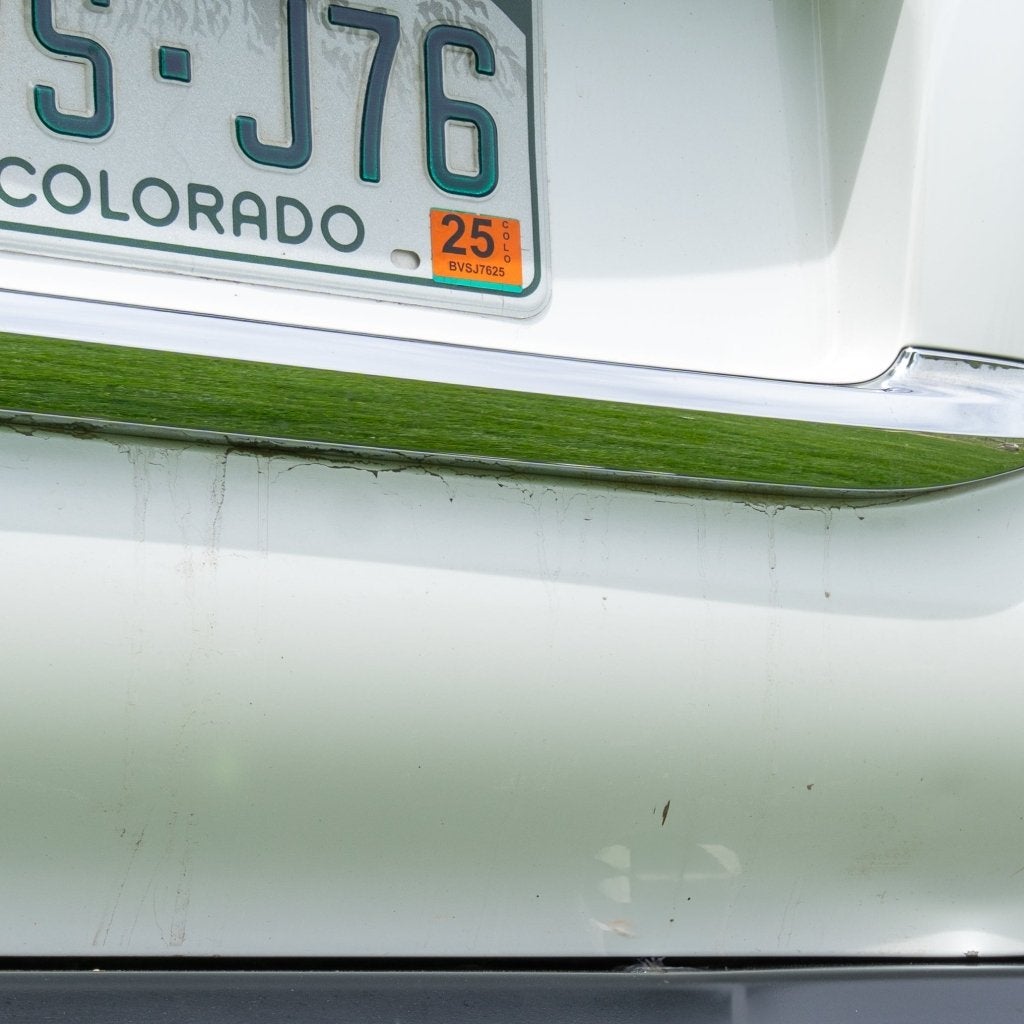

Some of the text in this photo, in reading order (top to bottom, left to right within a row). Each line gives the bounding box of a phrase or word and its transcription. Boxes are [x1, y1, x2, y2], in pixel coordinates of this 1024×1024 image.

[0, 156, 365, 253] COLORADO
[441, 213, 495, 258] 25
[449, 260, 505, 277] BVSJ7625
